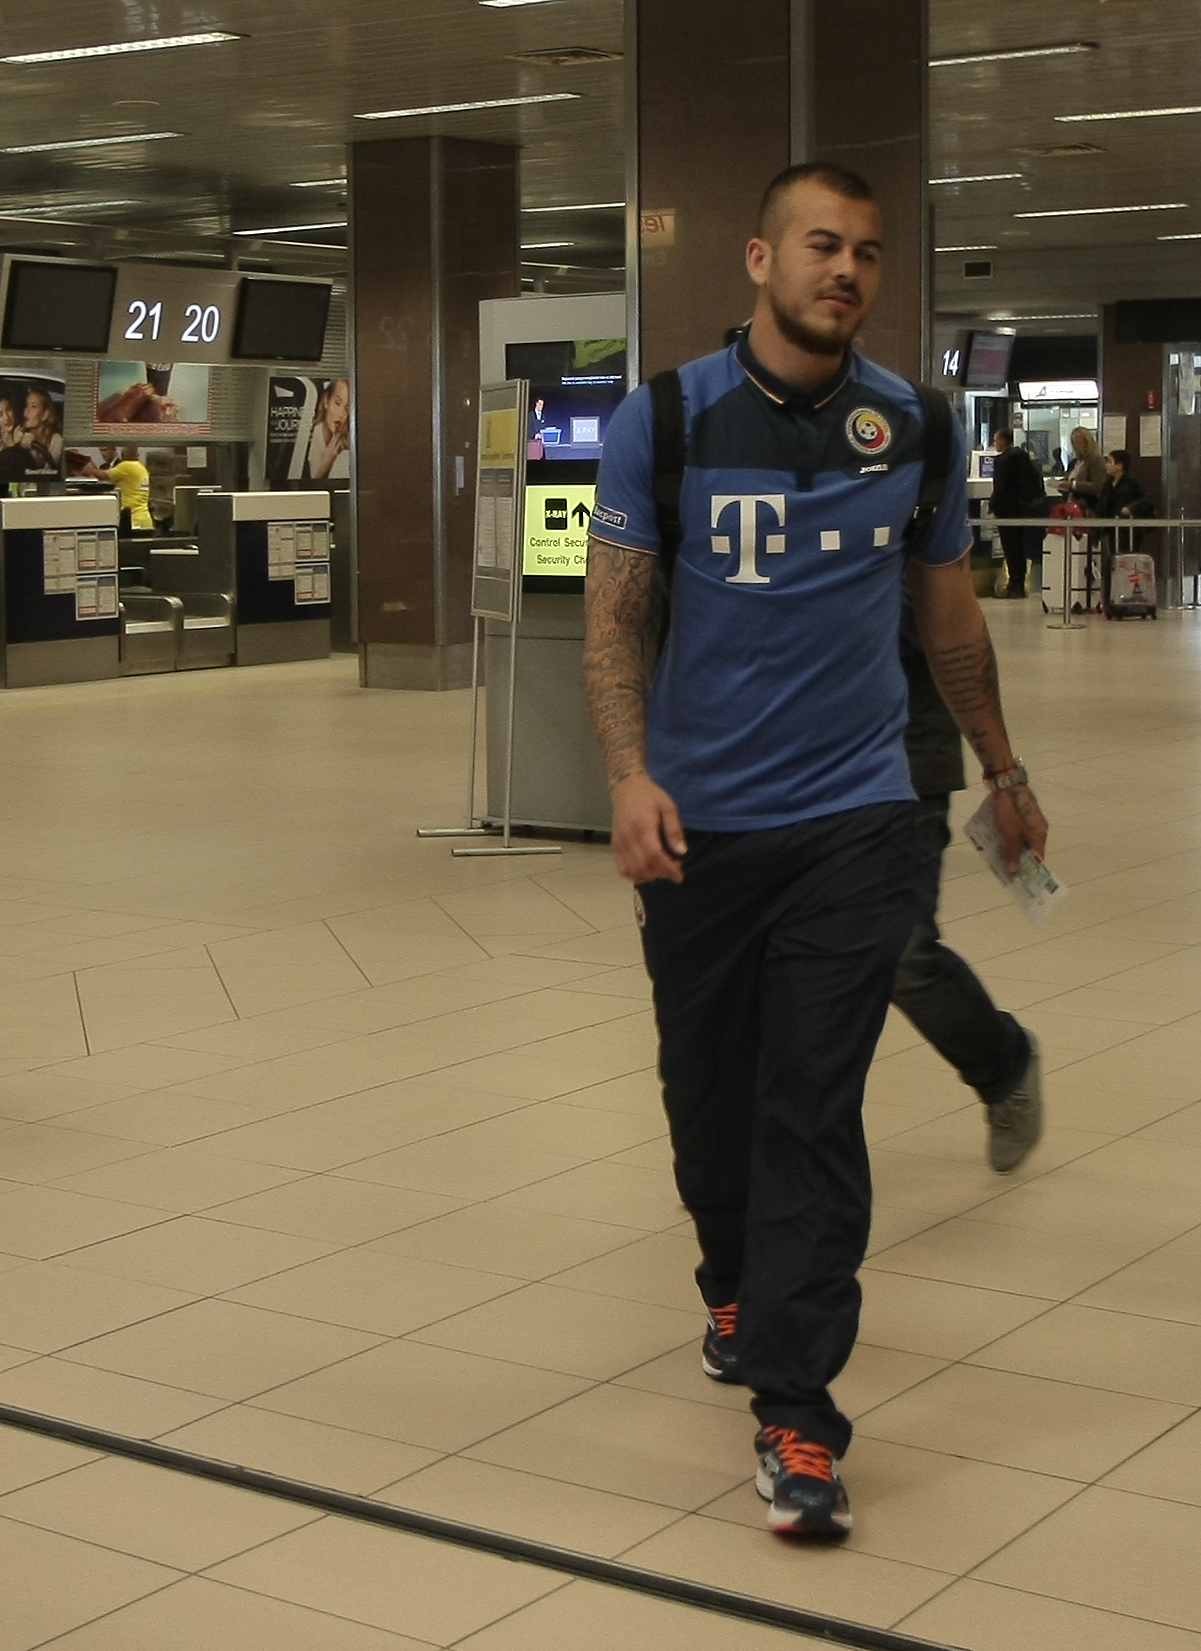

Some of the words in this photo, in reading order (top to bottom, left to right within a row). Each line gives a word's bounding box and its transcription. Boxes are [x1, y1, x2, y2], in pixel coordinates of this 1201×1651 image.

[124, 300, 163, 341] 21
[181, 304, 221, 343] 20
[942, 349, 961, 376] 14
[545, 510, 567, 519] X-RAY
[529, 537, 561, 548] Control
[536, 554, 571, 566] Security
